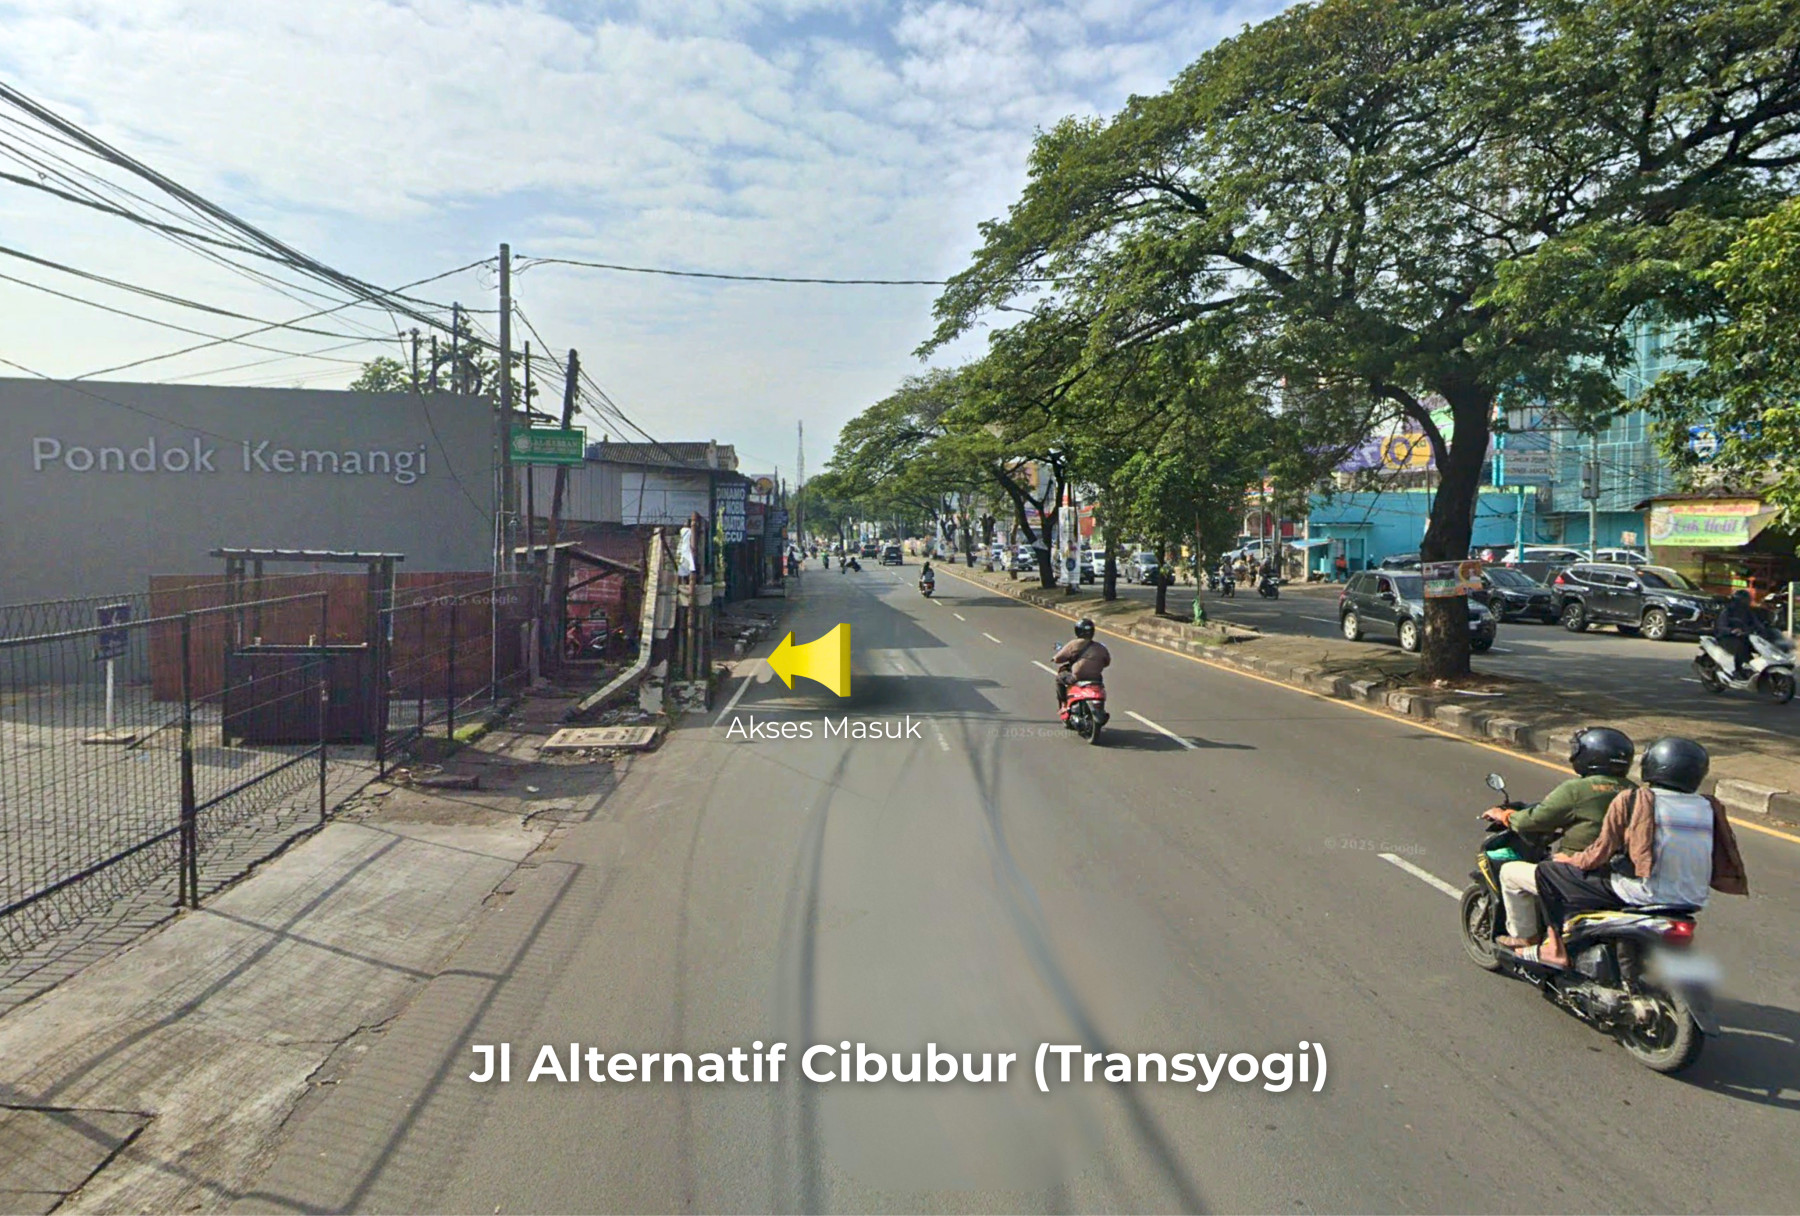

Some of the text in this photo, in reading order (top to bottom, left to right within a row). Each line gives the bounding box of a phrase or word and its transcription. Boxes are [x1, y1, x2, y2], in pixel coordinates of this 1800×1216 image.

[33, 437, 427, 485] Pondok Kemangi
[716, 487, 746, 500] DINAMO
[724, 531, 743, 542] CCU
